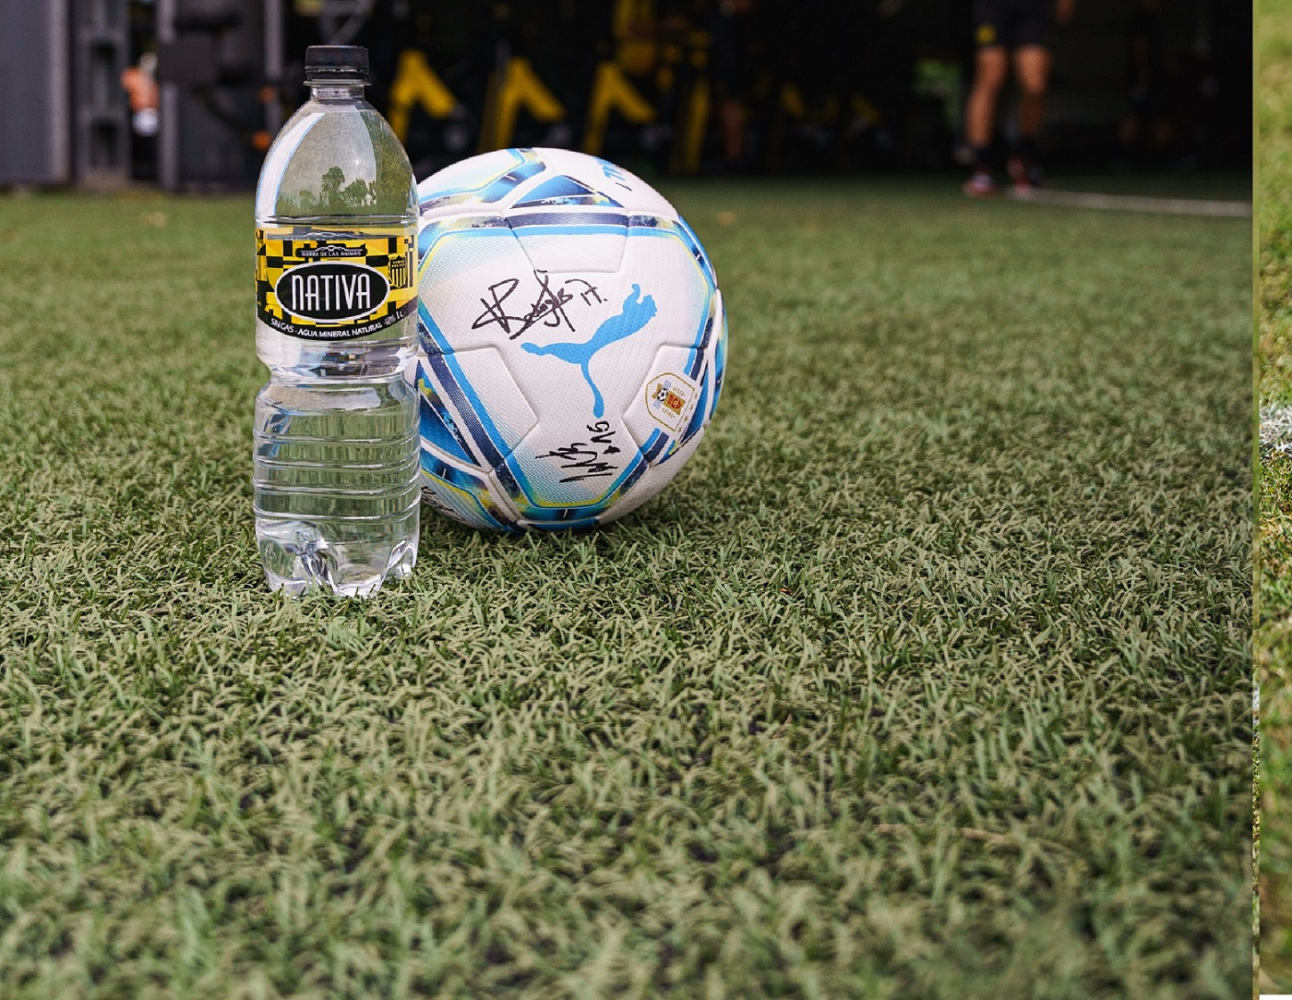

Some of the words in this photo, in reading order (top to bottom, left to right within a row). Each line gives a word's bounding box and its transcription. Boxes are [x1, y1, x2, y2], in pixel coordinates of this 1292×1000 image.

[291, 273, 371, 312] NATIVA
[270, 318, 281, 329] SIN
[297, 328, 318, 337] AGUA
[319, 330, 351, 338] MINERAL
[352, 322, 383, 336] NATURAL
